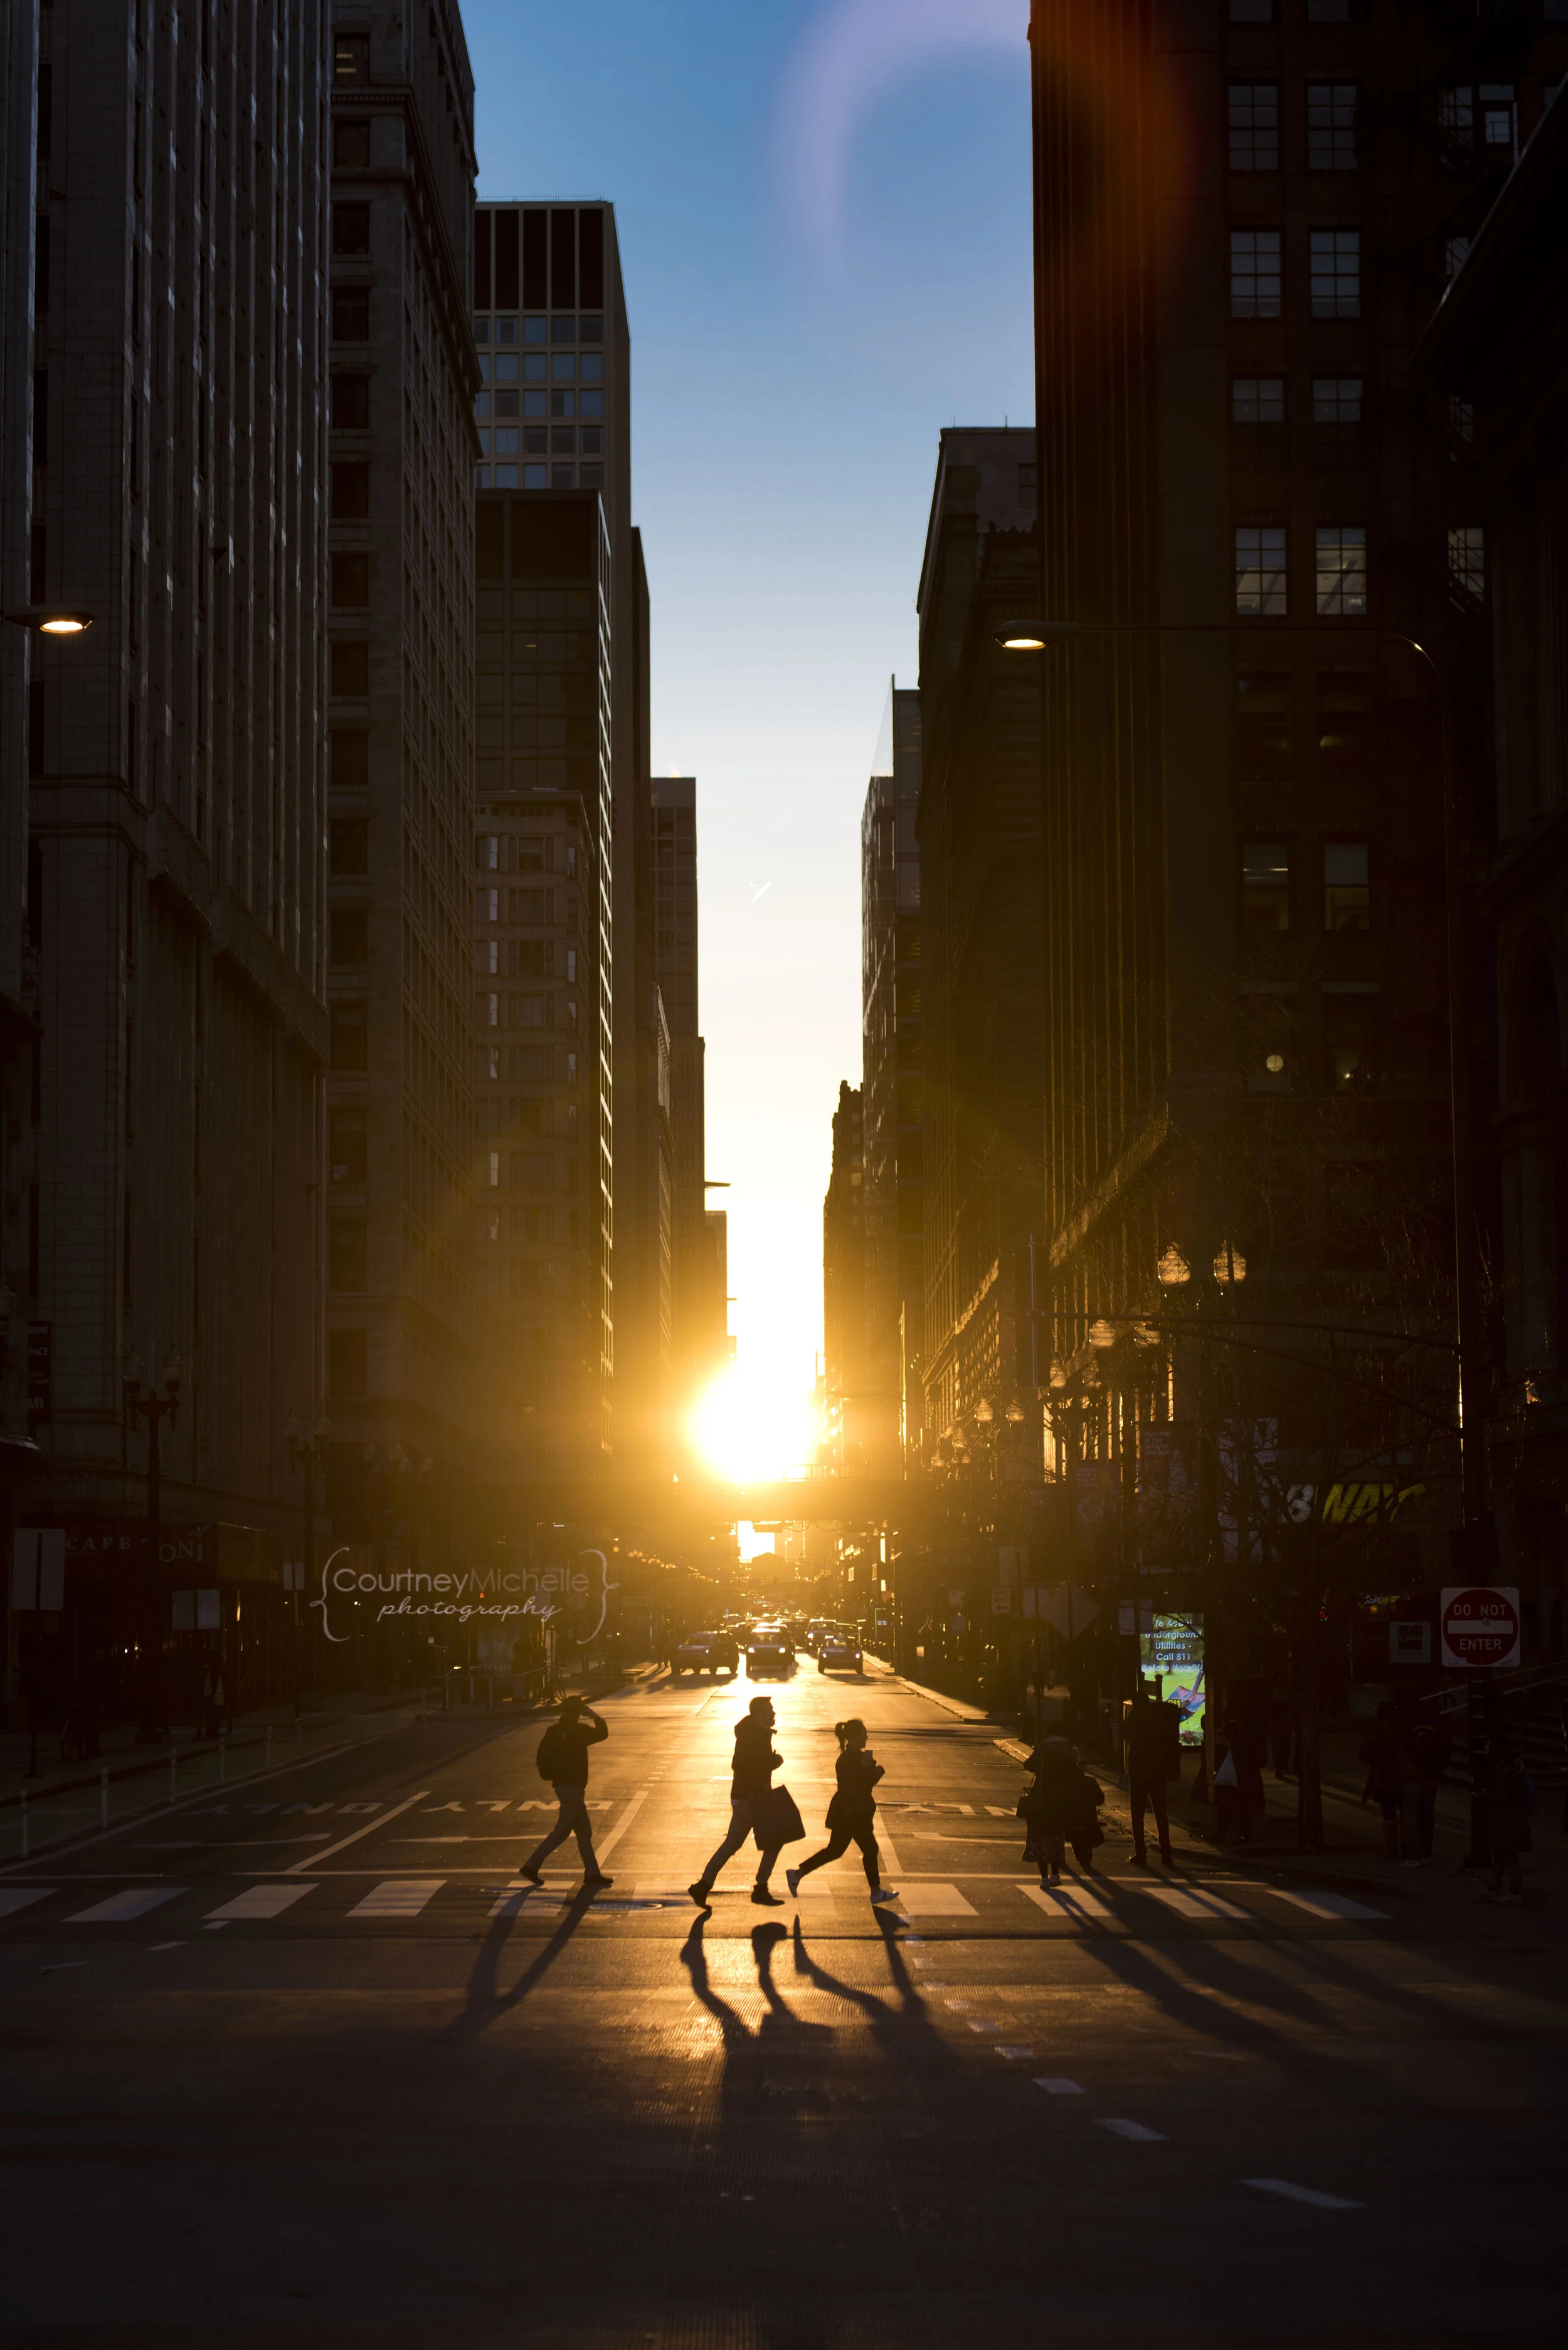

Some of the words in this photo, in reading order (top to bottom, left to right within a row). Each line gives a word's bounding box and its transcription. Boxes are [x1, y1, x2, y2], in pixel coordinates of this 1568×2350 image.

[28, 1325, 49, 1334] RIME
[28, 1347, 49, 1356] PACE
[65, 1536, 131, 1550] CAFE
[1453, 1604, 1471, 1616] DO
[1480, 1604, 1507, 1616] NOT
[1459, 1638, 1502, 1651] ENTER
[181, 1803, 384, 1815] ONLY
[893, 1804, 1019, 1817] NLY
